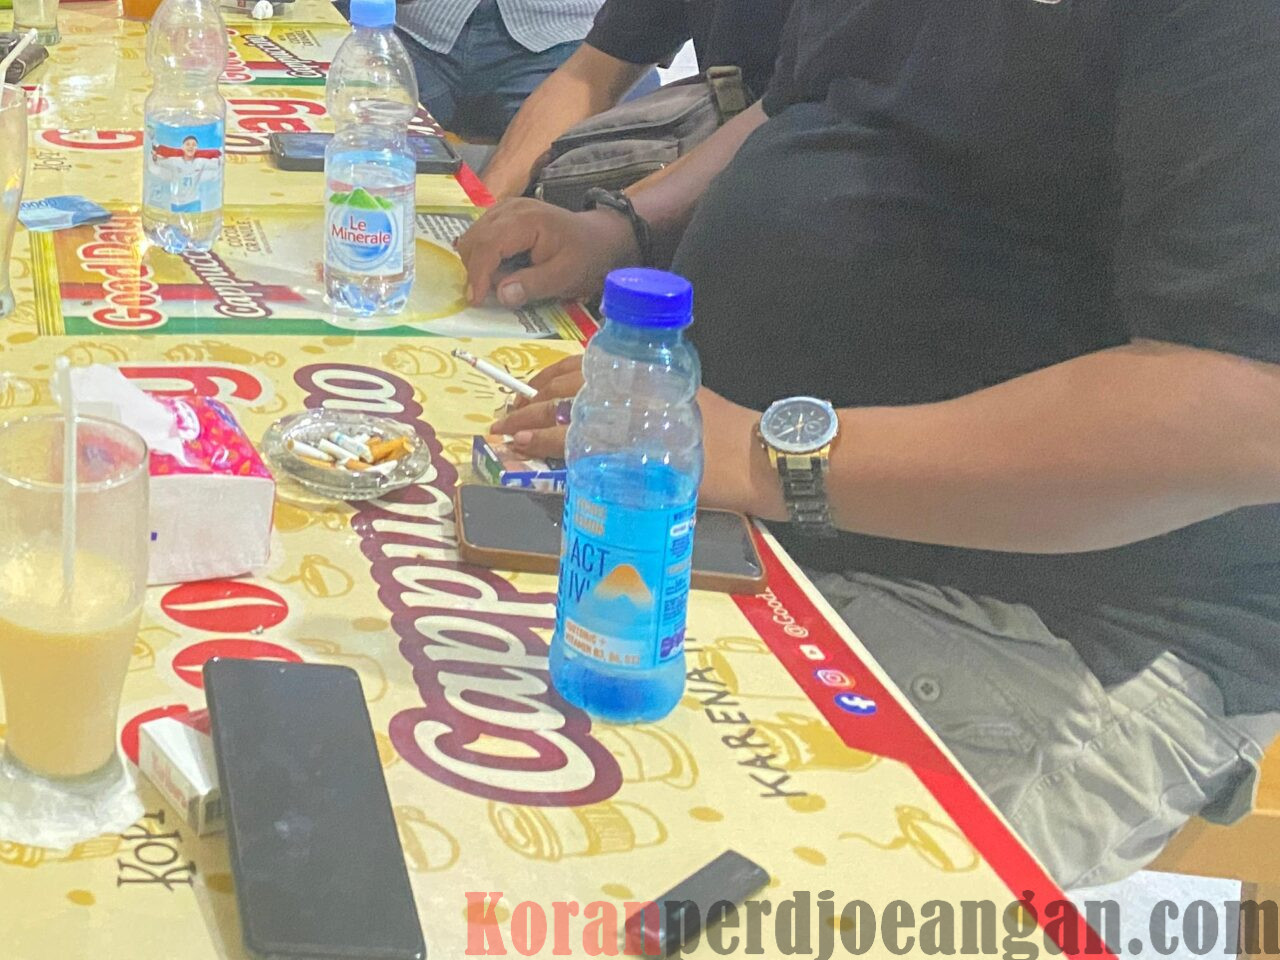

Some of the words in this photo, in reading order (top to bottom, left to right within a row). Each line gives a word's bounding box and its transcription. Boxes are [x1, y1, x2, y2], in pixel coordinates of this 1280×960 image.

[331, 223, 392, 246] Minerale
[349, 215, 367, 232] Le
[182, 248, 274, 320] Cappucc
[571, 536, 610, 578] ACT
[684, 666, 808, 800] KARENA
